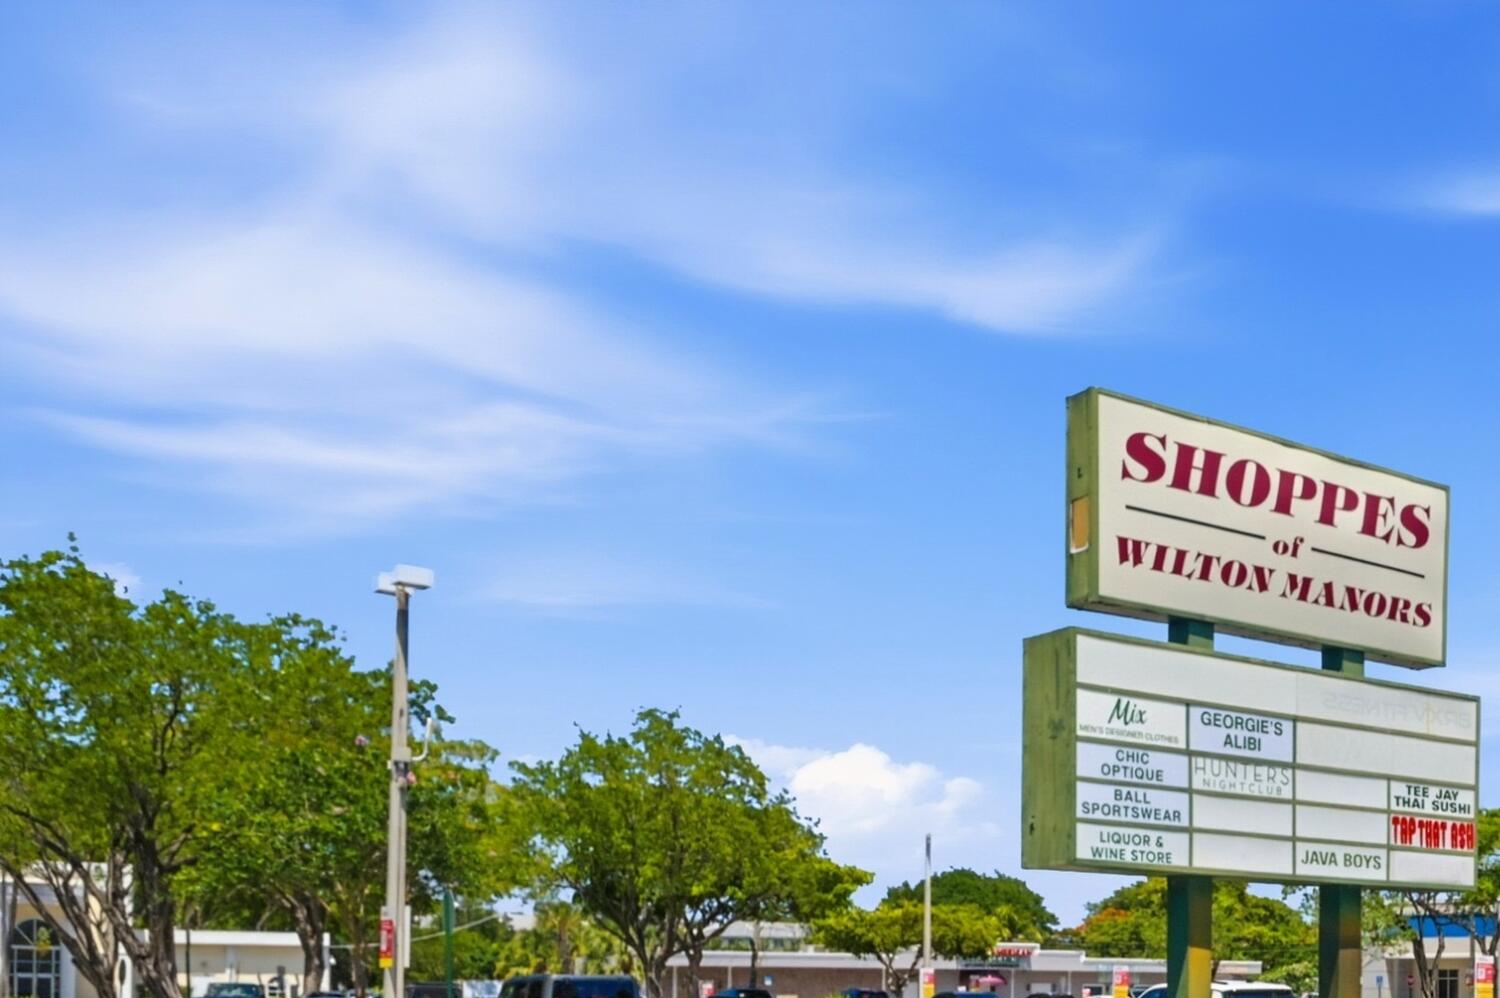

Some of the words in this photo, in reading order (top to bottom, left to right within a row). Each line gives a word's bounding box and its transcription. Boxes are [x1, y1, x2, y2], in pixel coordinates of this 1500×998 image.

[1121, 431, 1432, 550] SHOPPES
[1272, 536, 1305, 559] of
[1116, 535, 1276, 594] WILTON
[1278, 572, 1433, 629] MANORS
[1107, 697, 1147, 727] Mix
[1079, 724, 1104, 735] MEN'S
[1105, 727, 1144, 739] DESIGNER
[1145, 732, 1180, 744] CLOTHES
[1200, 710, 1284, 737] GEORGIE'S
[1223, 732, 1262, 752] ALIBI
[1115, 749, 1150, 766] CHIC
[1100, 762, 1164, 783] OPTIQUE
[1194, 757, 1290, 786] HUNTERS
[1114, 788, 1152, 805] BALL
[1202, 778, 1283, 796] NIGHTCLUB
[1406, 784, 1430, 799] TEE
[1435, 788, 1459, 801] JAY
[1081, 801, 1182, 822] SPORTSWEAR
[1394, 795, 1425, 809] THAI
[1431, 800, 1471, 815] SUSHI
[1099, 831, 1151, 847] LIQUOR
[1155, 835, 1164, 848] &
[1391, 815, 1417, 846] TAP
[1418, 818, 1447, 849] THAT
[1450, 822, 1475, 850] ASH
[1090, 846, 1126, 861] WINE
[1130, 849, 1172, 865] STORE
[1301, 849, 1339, 867] JAVA
[1343, 852, 1382, 871] BOYS
